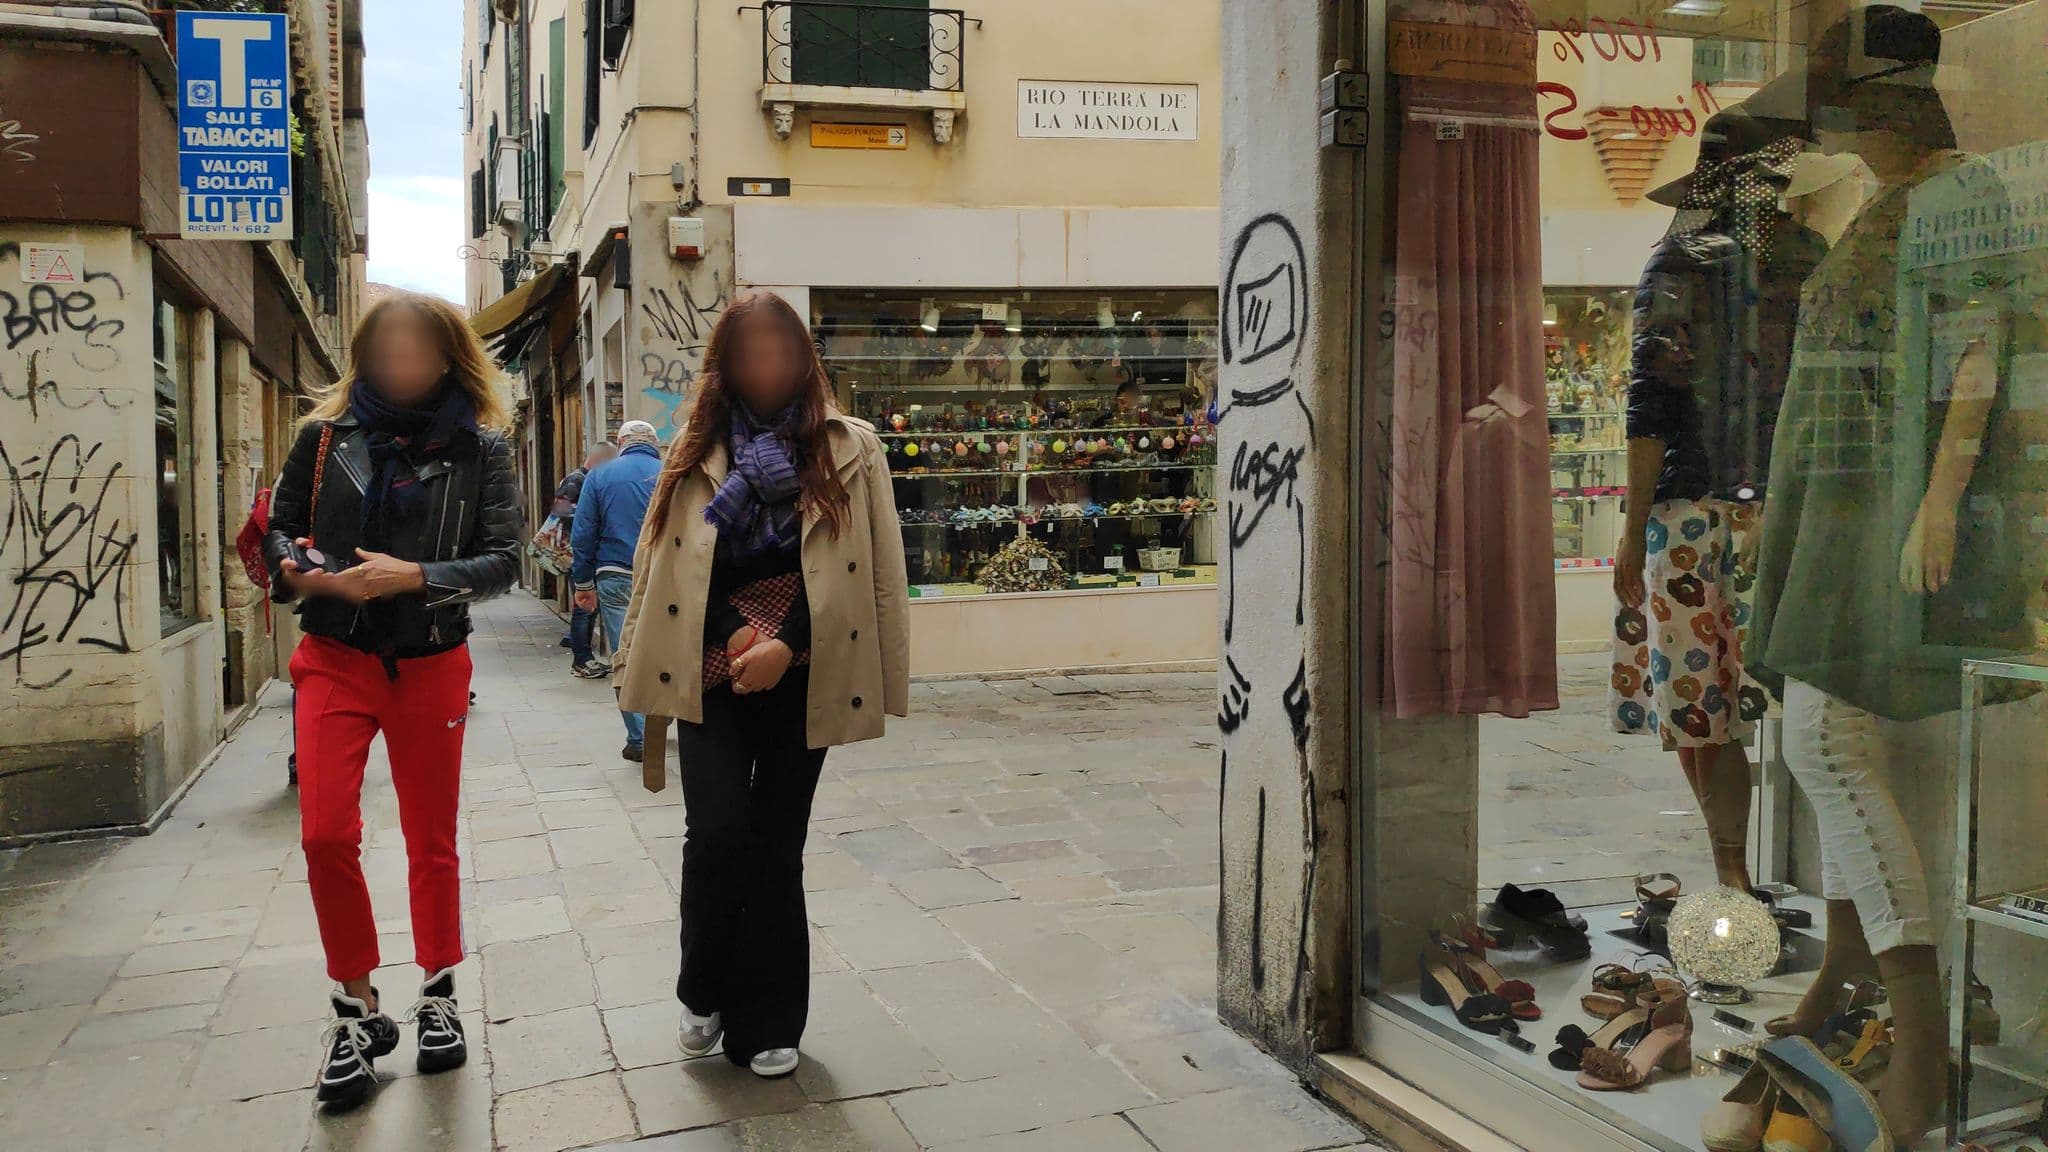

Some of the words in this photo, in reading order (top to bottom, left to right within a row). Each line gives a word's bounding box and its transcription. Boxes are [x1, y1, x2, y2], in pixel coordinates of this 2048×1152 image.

[192, 18, 272, 108] T
[259, 90, 273, 107] 6
[1027, 88, 1066, 105] RIO
[1160, 93, 1187, 109] DE
[205, 110, 246, 125] SALI
[251, 112, 263, 125] E
[1034, 112, 1061, 129] LA
[1074, 114, 1179, 132] MANDOLA
[183, 126, 286, 148] TABACCHI
[201, 159, 268, 174] VALORI
[196, 175, 274, 190] BOLLATI
[188, 196, 283, 223] LOTTO
[245, 225, 270, 233] 682
